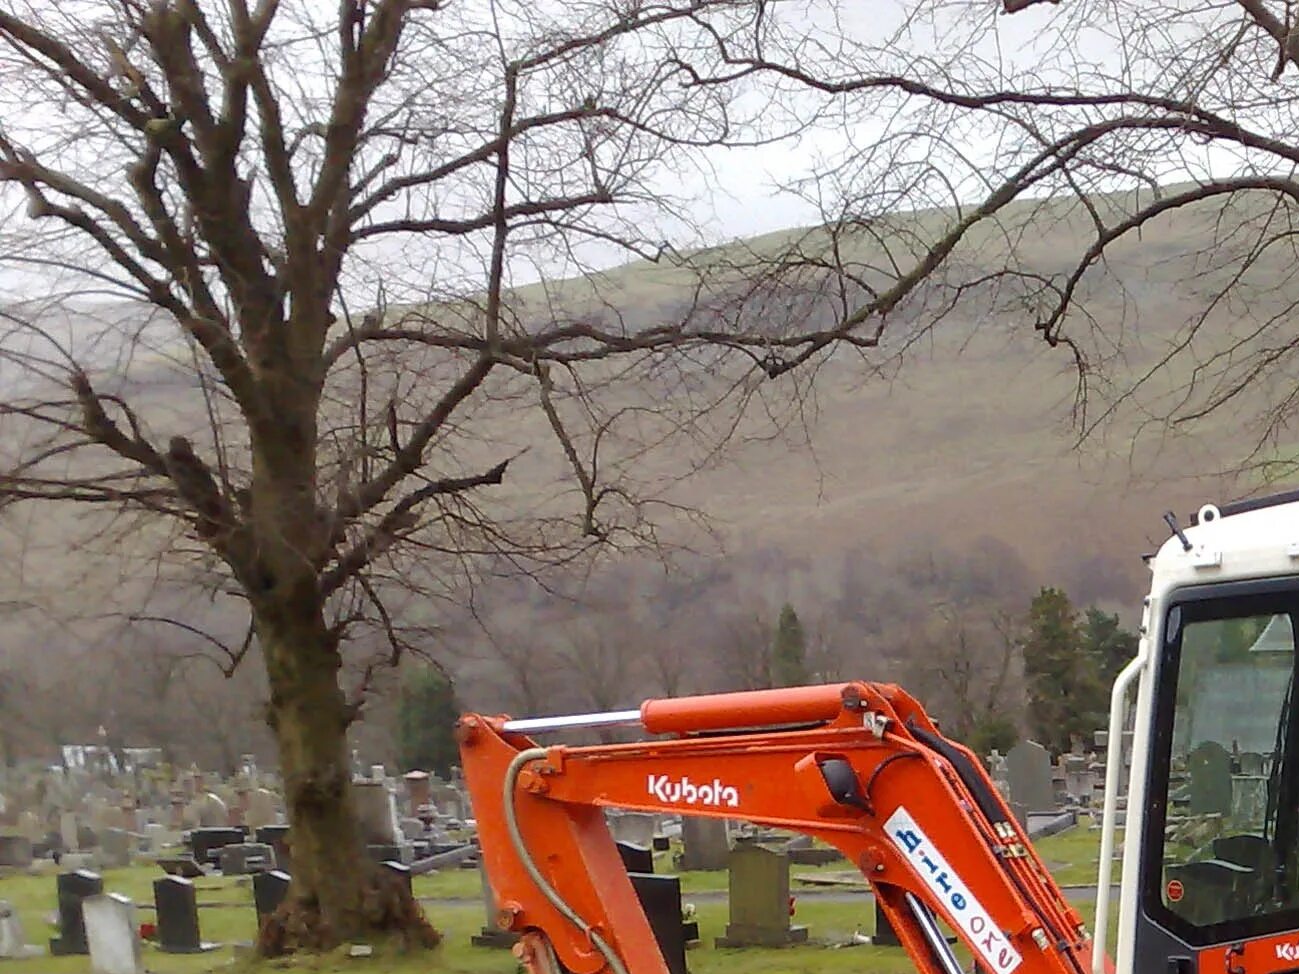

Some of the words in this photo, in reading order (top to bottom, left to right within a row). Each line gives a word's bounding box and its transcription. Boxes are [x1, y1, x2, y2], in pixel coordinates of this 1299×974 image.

[647, 774, 739, 807] Kubota
[896, 829, 967, 910] hire
[970, 916, 1014, 969] one
